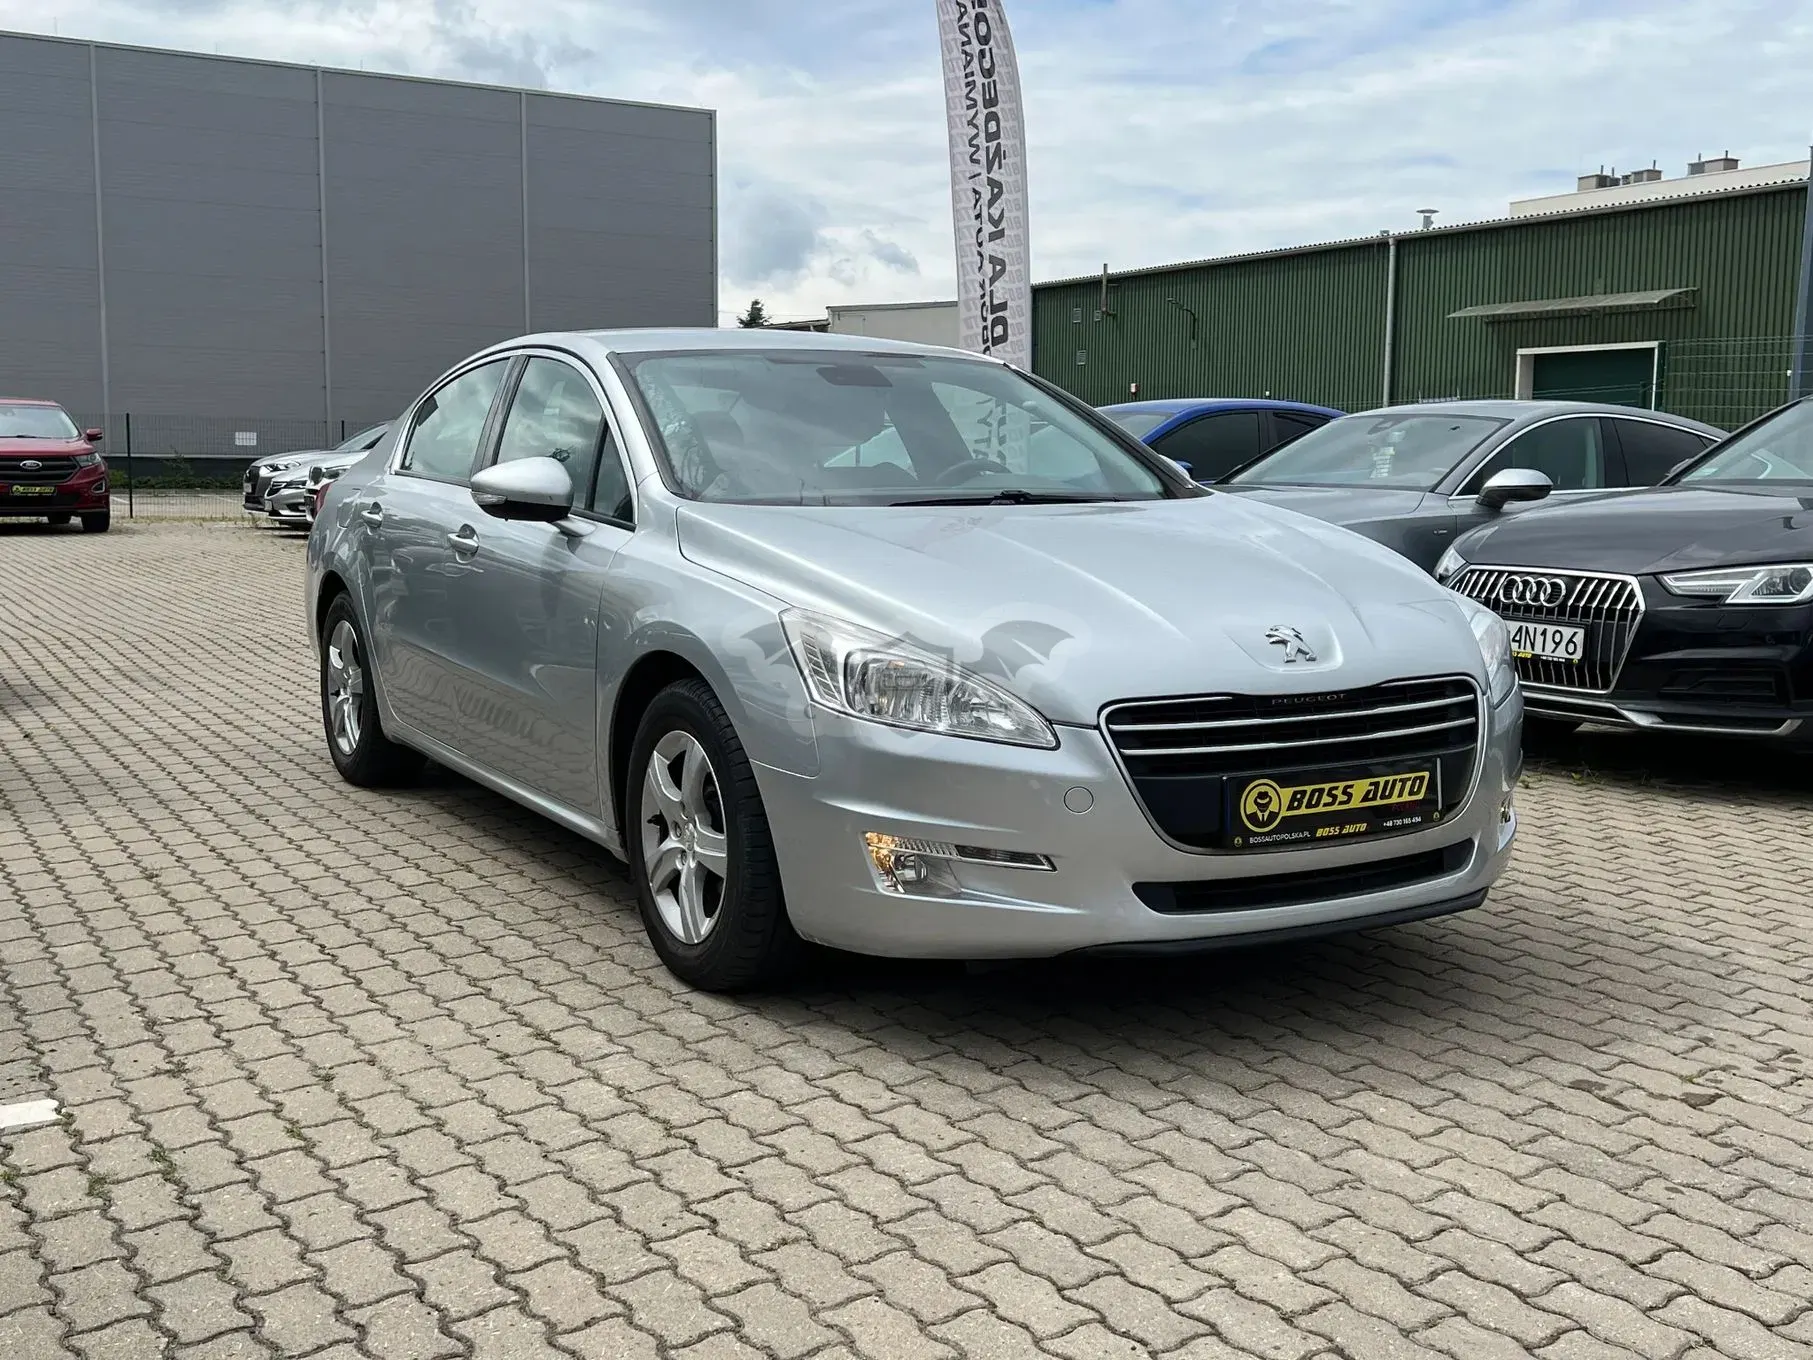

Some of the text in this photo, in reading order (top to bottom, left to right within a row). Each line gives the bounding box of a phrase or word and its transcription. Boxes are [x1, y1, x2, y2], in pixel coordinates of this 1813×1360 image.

[1511, 624, 1579, 656] 4N196
[1271, 693, 1346, 705] PEUGEOT
[1285, 775, 1426, 812] BOSS AUTO
[1249, 830, 1311, 844] BOSSAUTOPOLSKA.PL
[1315, 822, 1368, 837] BOSS AUTO
